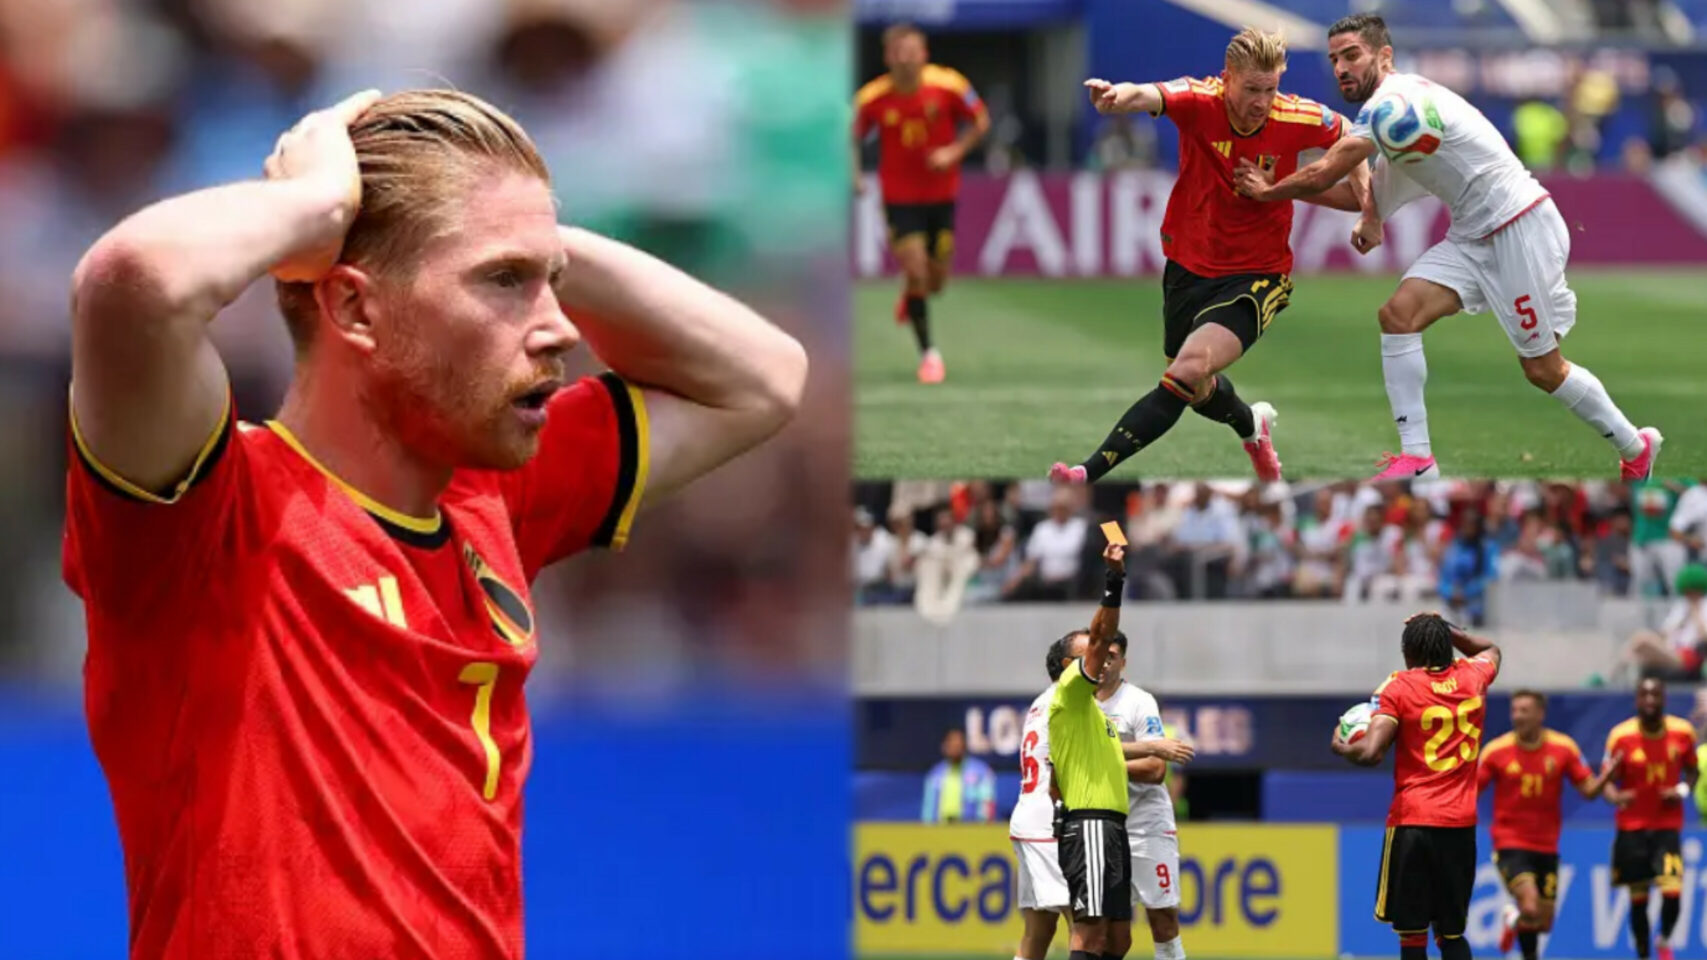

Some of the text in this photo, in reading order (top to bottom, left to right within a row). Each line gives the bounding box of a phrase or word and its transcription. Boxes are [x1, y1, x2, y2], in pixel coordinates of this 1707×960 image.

[1514, 294, 1539, 331] 5
[457, 661, 500, 801] 7
[963, 704, 1030, 757] LO
[1421, 695, 1483, 773] 25
[1520, 772, 1545, 798] 21
[858, 852, 1018, 924] erca
[1155, 862, 1171, 888] 9
